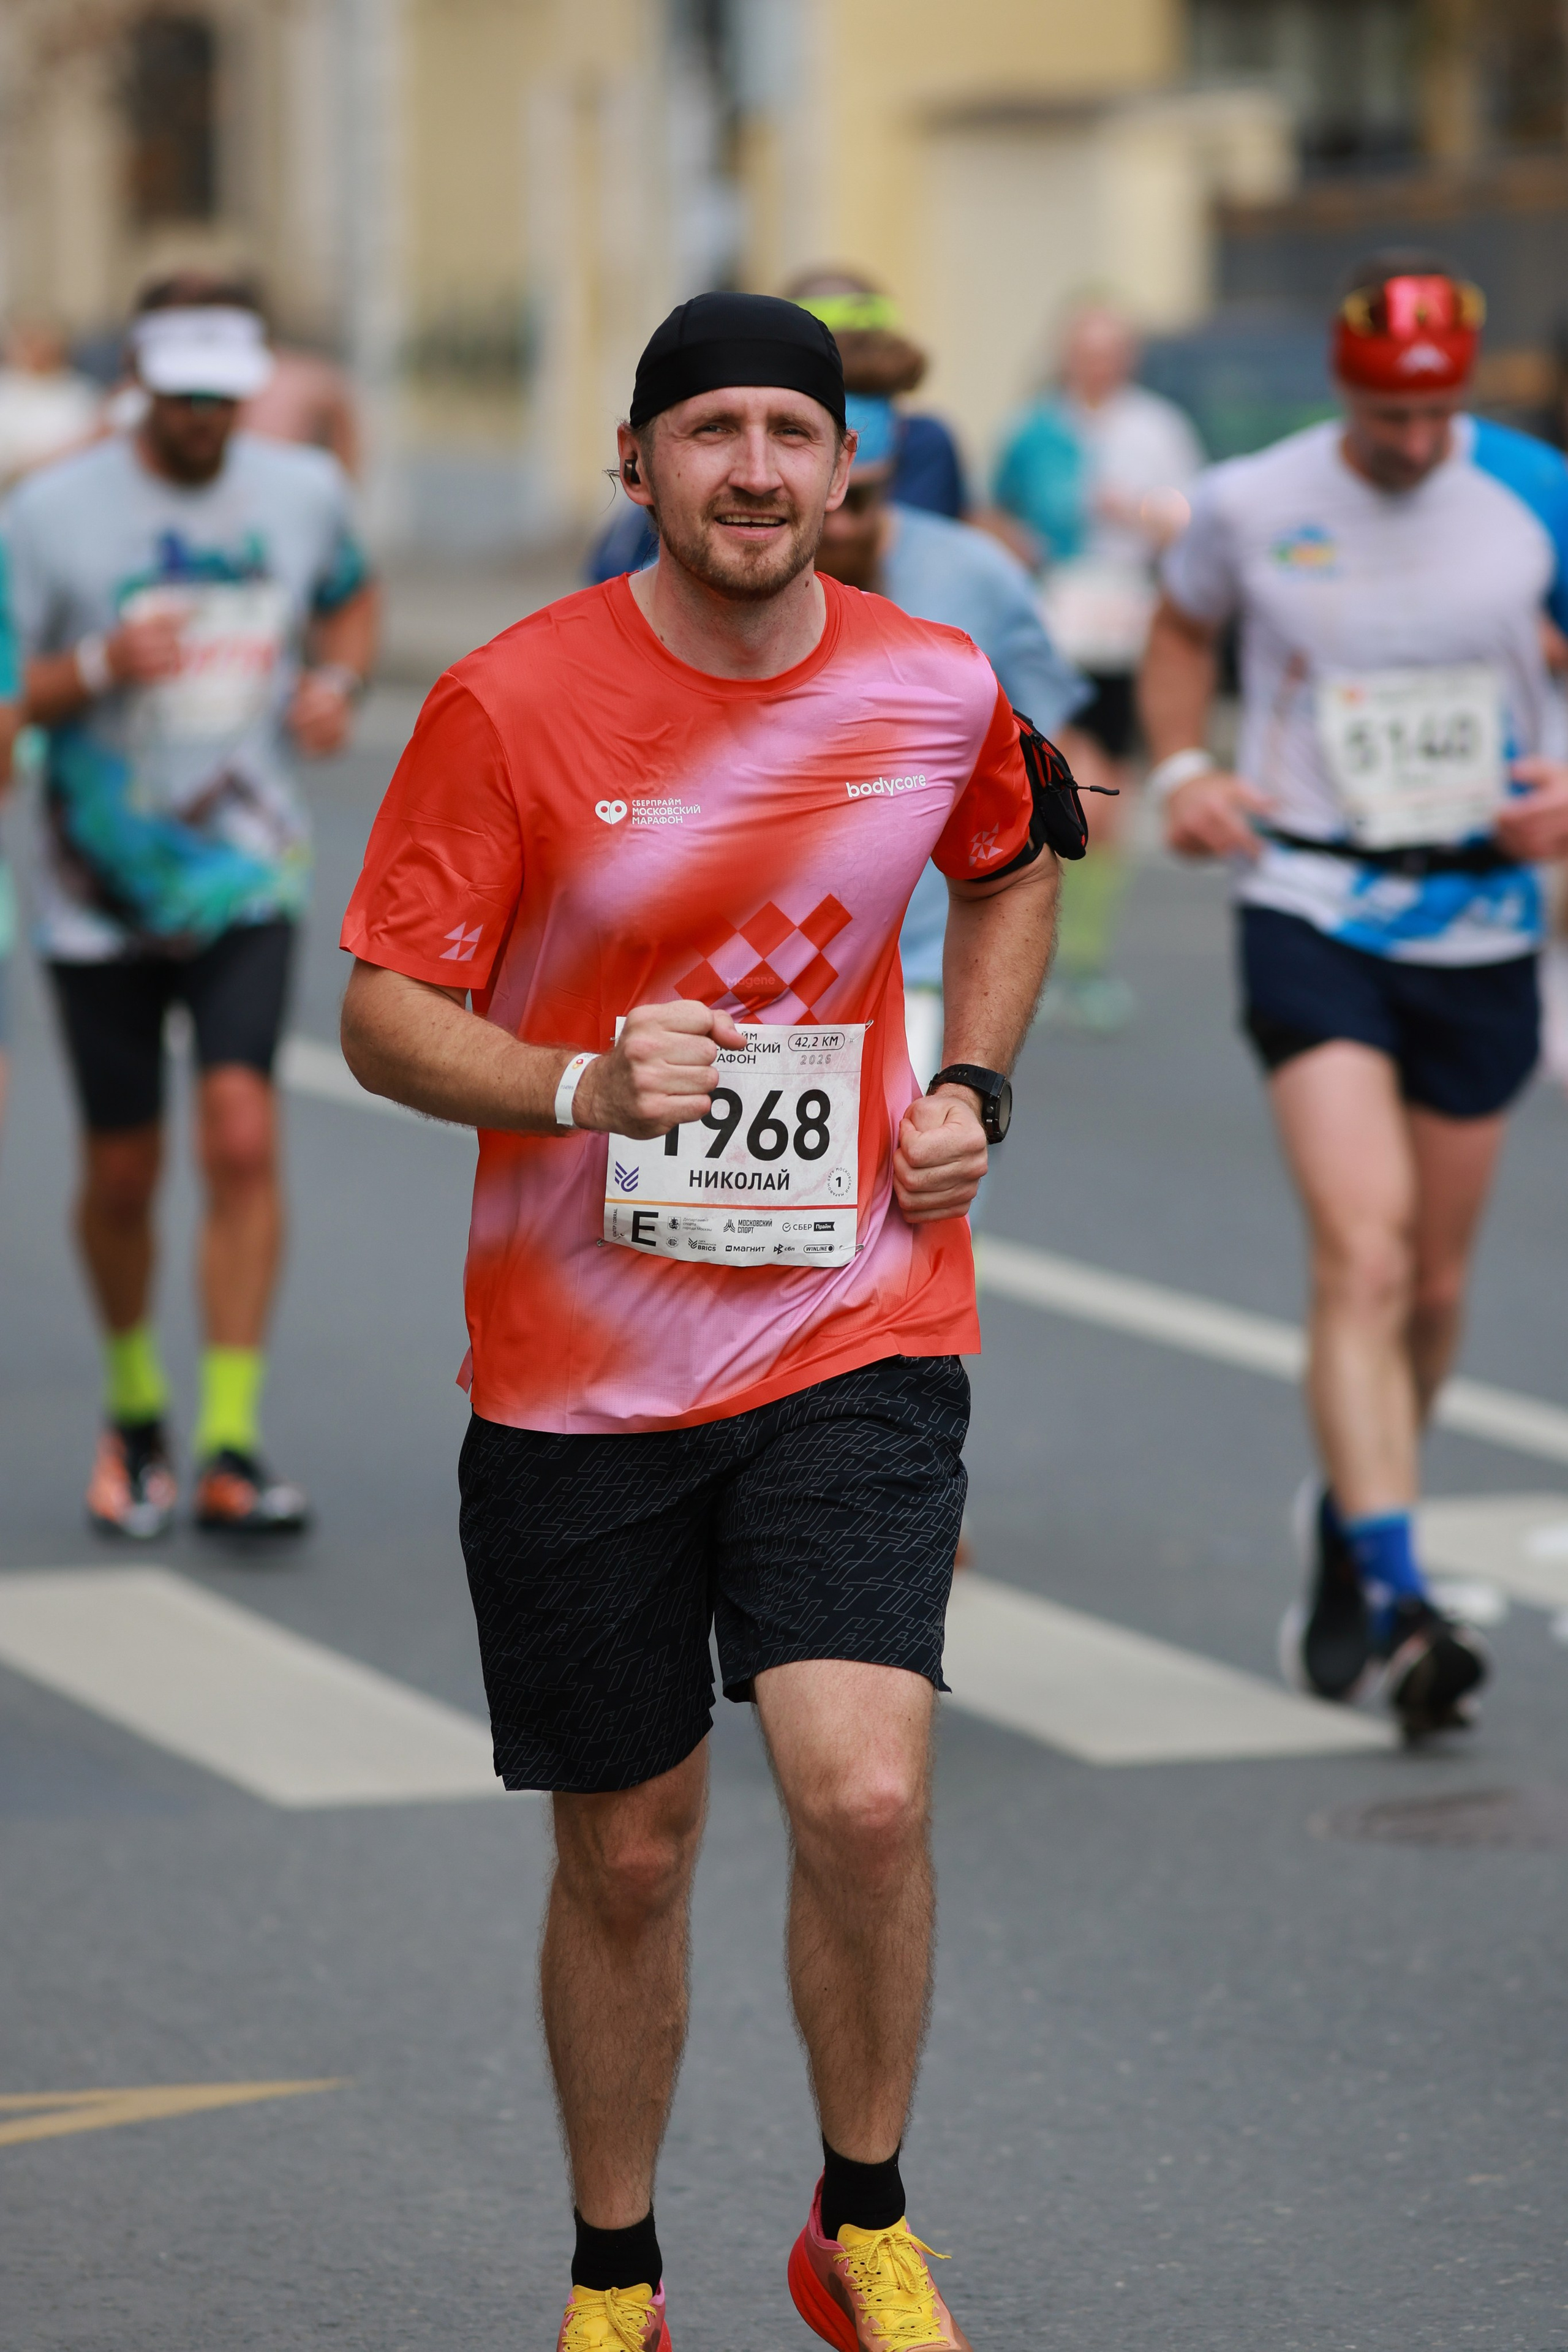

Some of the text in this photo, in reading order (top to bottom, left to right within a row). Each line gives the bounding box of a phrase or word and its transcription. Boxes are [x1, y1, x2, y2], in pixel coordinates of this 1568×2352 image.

[845, 774, 926, 797] bodycore
[631, 797, 682, 807] СБЕРПРАЙМ
[631, 804, 701, 816] МОСКОВСКИЙ
[631, 815, 683, 825] МАРАФОН
[795, 1036, 819, 1049] 42,2
[800, 1054, 832, 1065] 2026
[688, 1169, 790, 1191] НИКОЛАЙ
[835, 1176, 842, 1188] 1
[737, 1218, 773, 1227] МОСКОВСКИЙ
